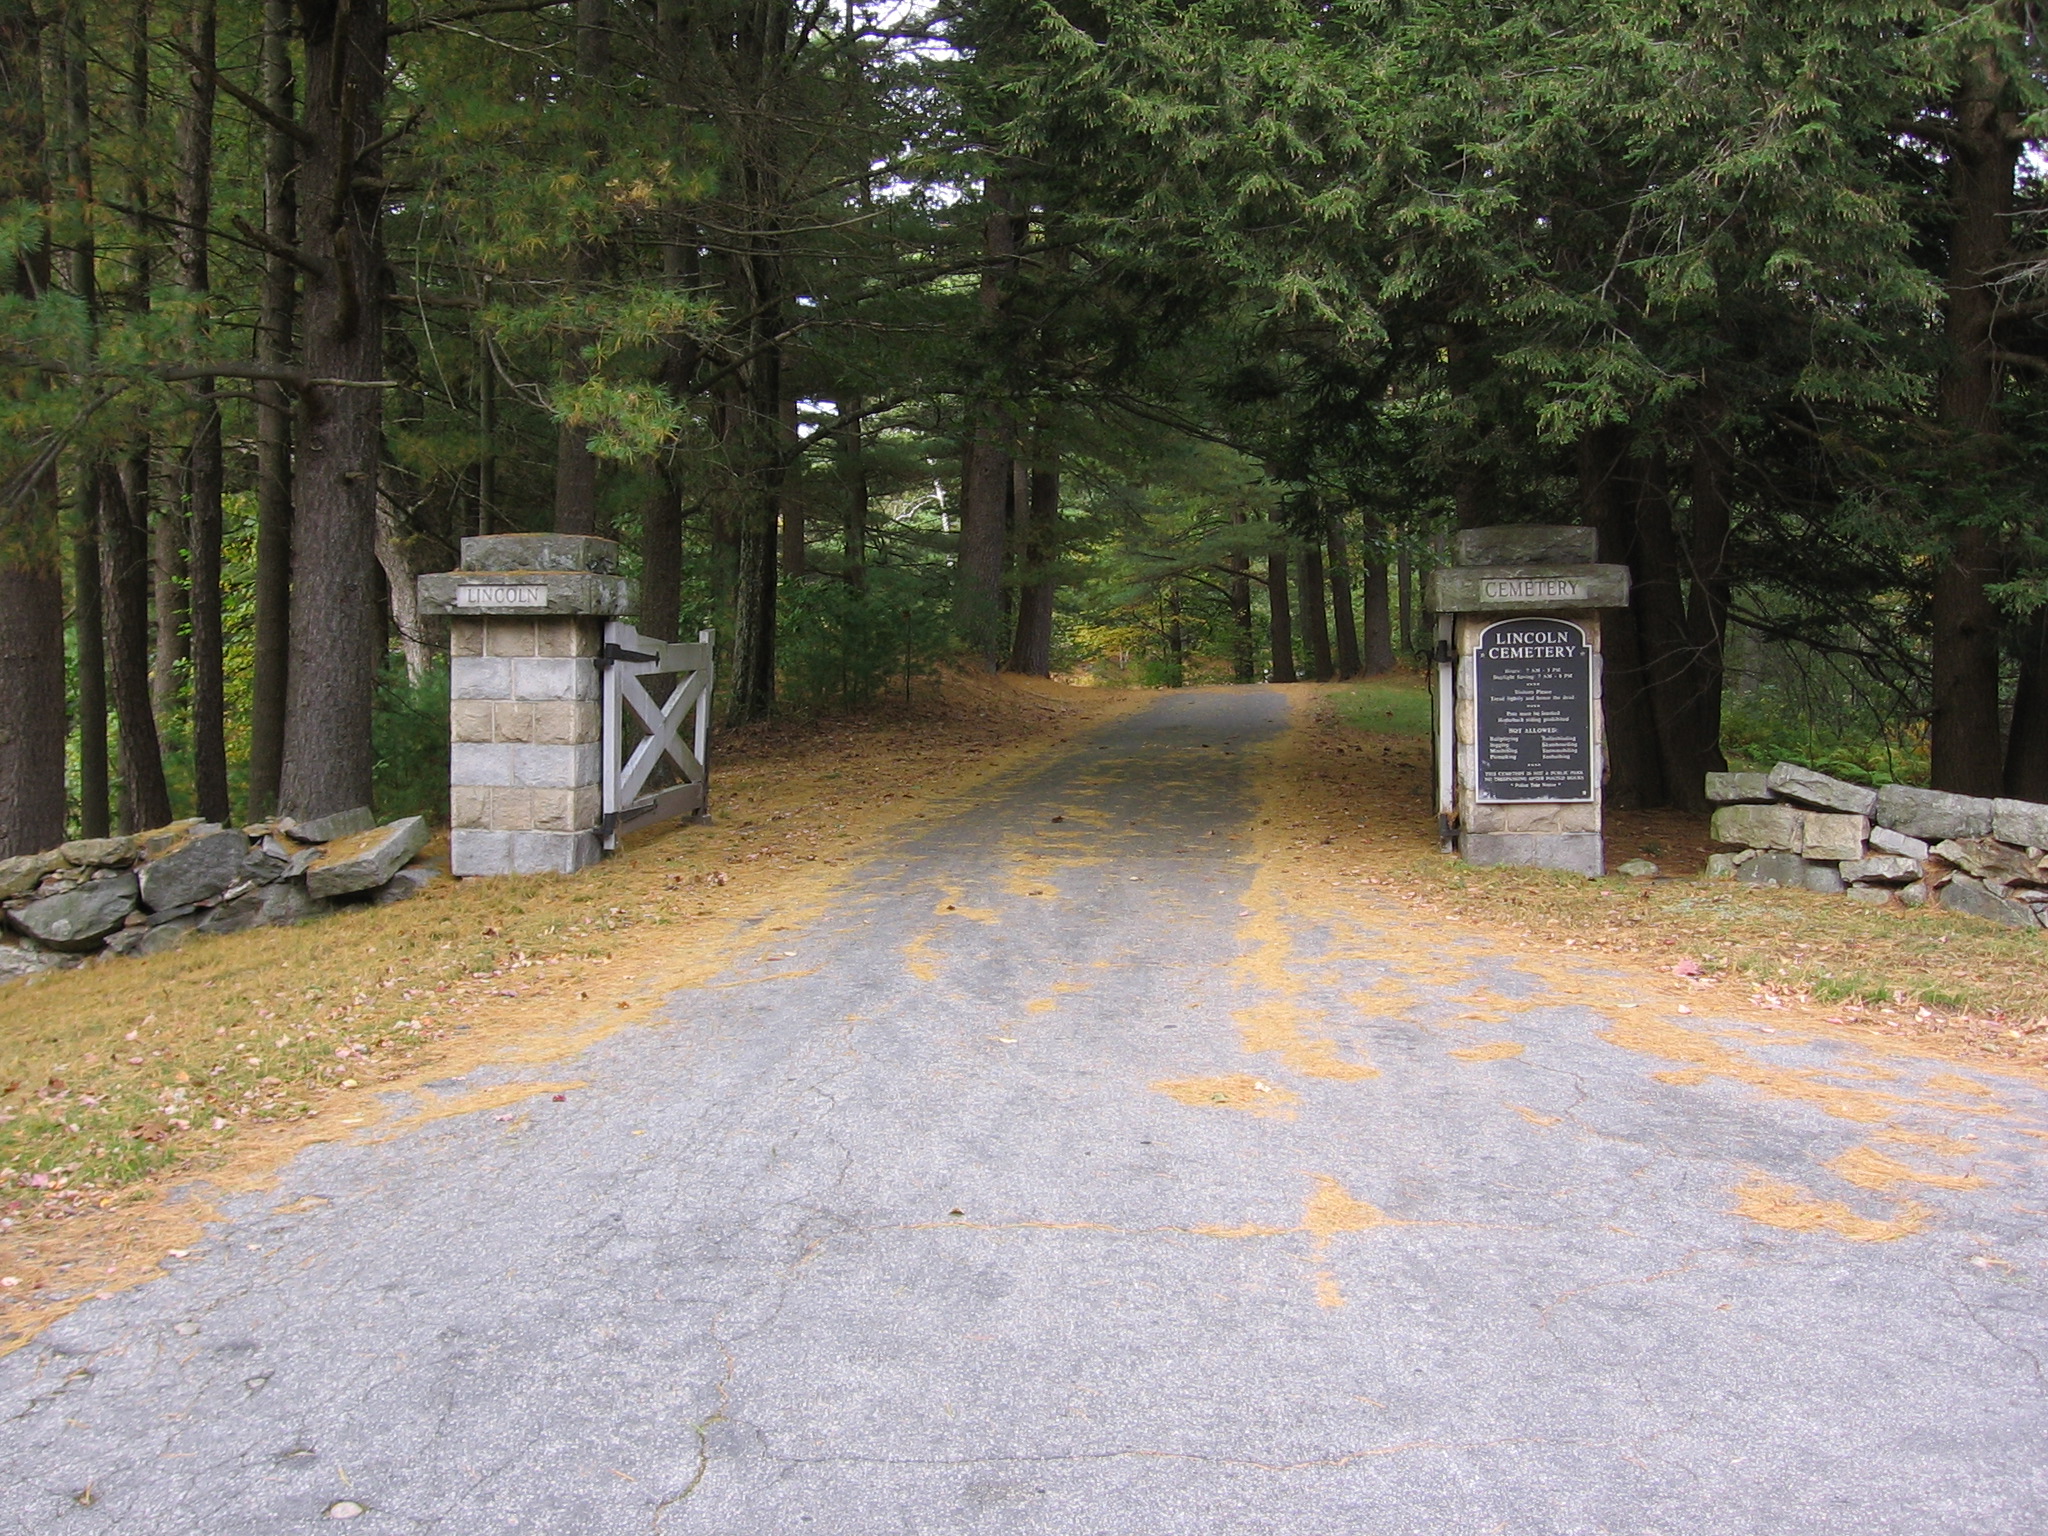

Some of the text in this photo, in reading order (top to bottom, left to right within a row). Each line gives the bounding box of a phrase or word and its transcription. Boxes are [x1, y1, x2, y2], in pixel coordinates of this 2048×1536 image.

[467, 587, 539, 604] LINCOLN
[1485, 580, 1579, 598] CEMETERY
[1495, 631, 1569, 645] LINCOLN
[1488, 646, 1576, 659] CEMETERY
